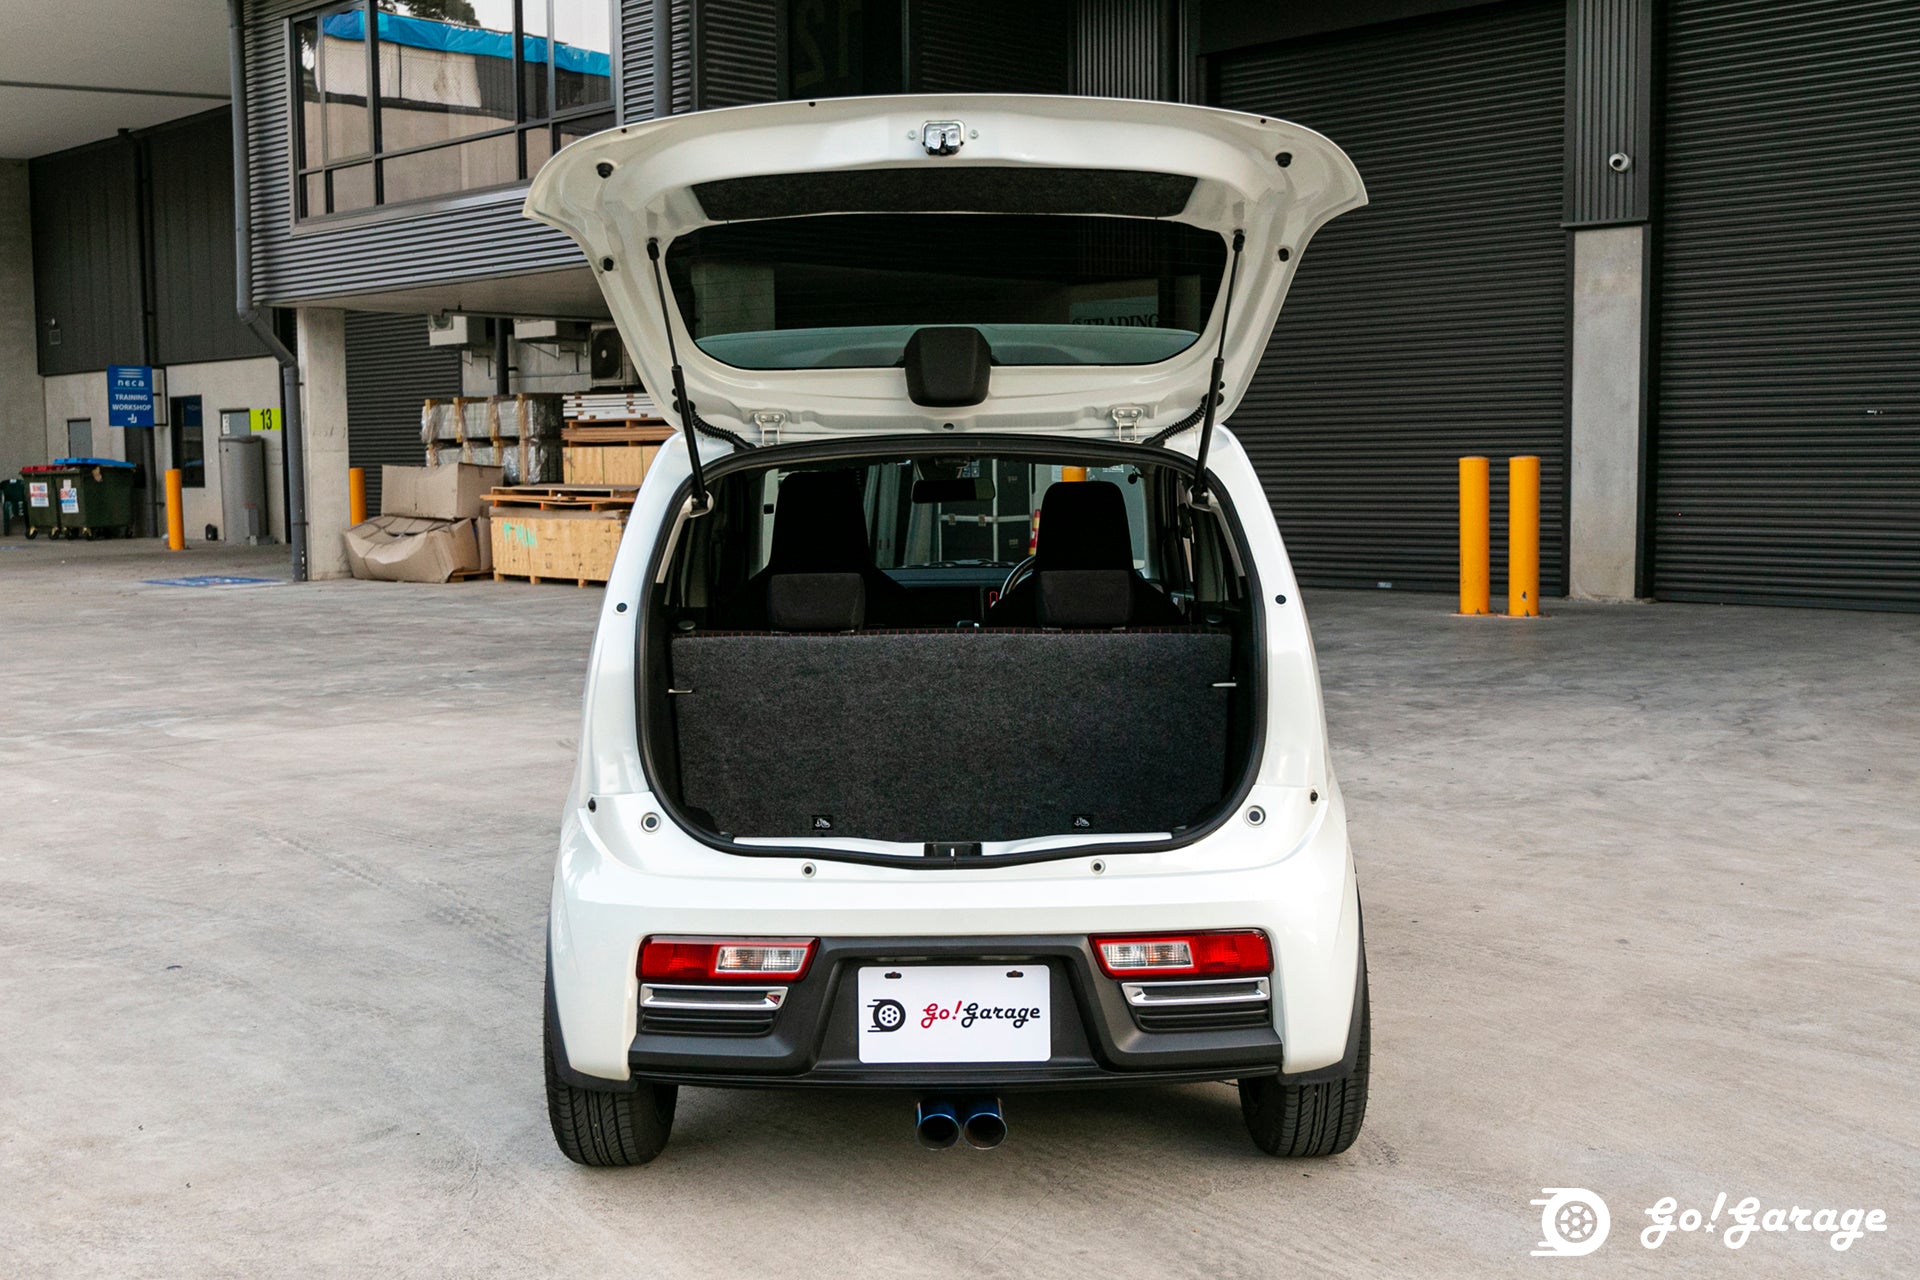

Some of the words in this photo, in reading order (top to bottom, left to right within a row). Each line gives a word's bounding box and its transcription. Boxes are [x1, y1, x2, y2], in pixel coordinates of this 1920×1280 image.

[114, 393, 148, 401] TRAINING
[111, 403, 152, 411] WORKSHOP
[260, 408, 273, 430] 13
